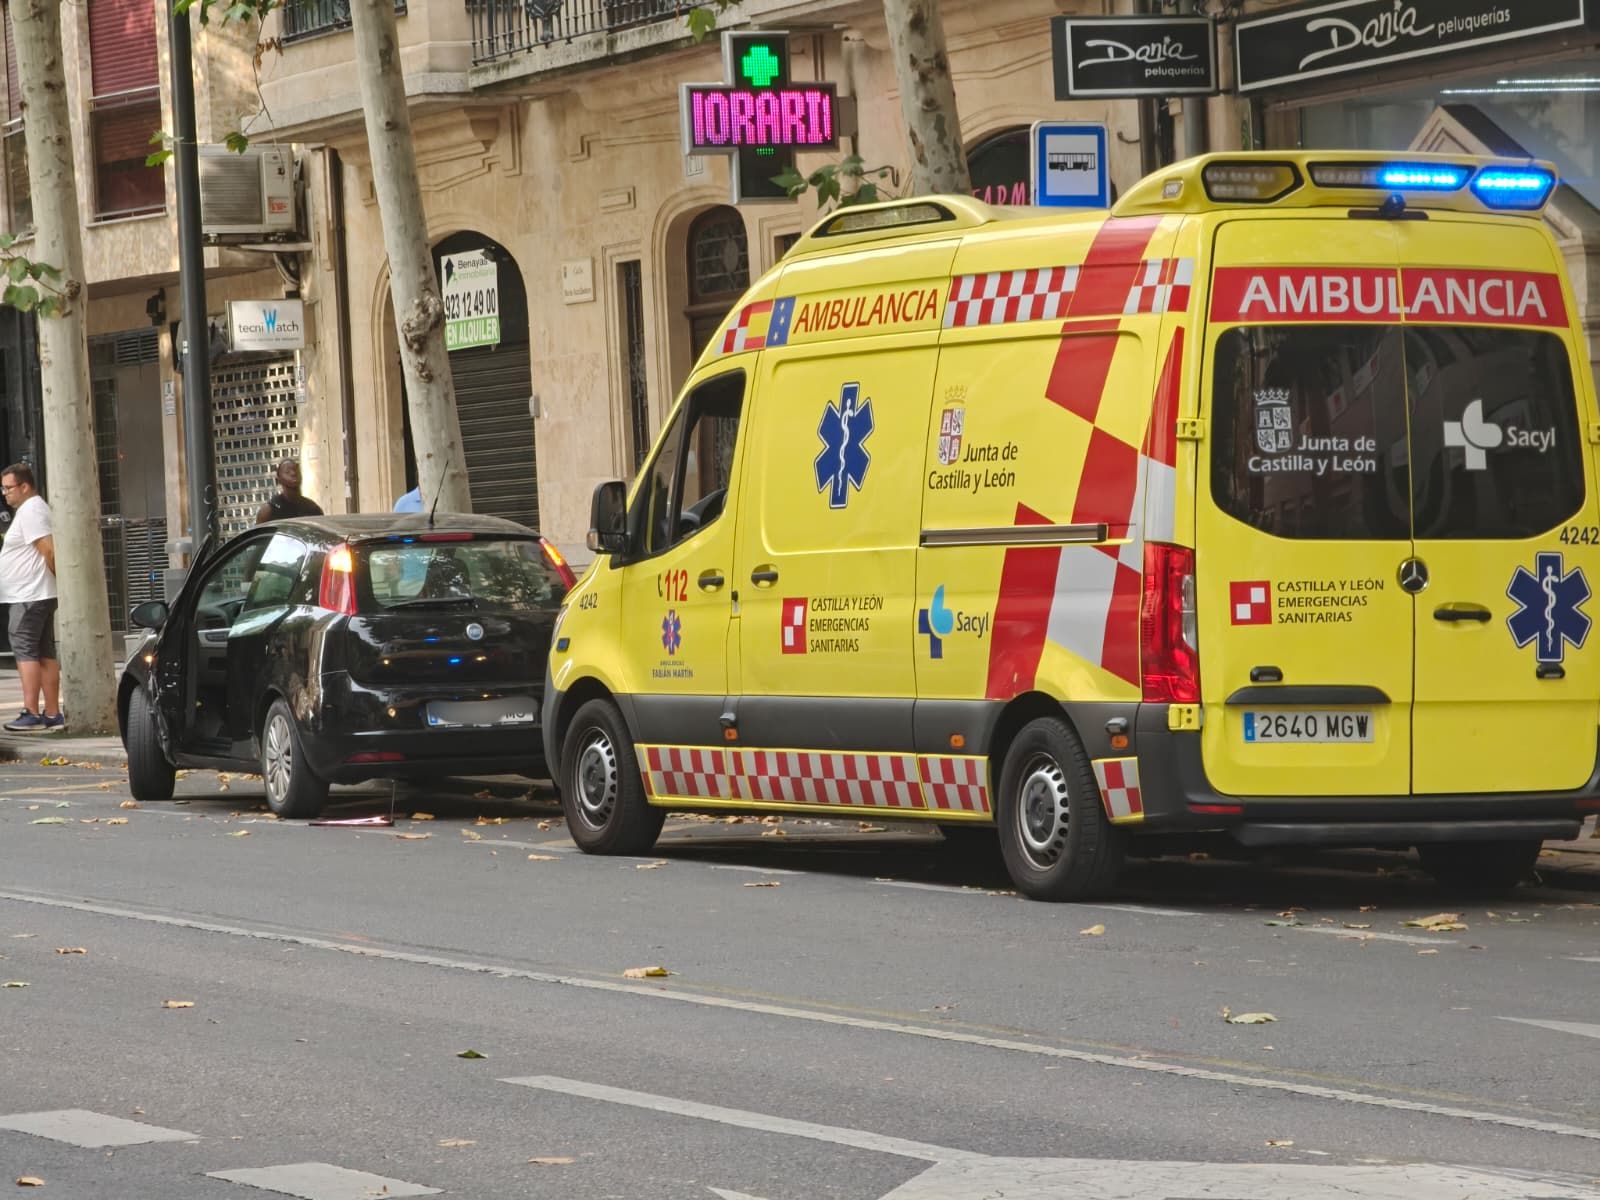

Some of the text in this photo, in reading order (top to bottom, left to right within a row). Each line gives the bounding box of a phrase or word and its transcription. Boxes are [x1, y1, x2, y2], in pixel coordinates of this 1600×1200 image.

[1299, 0, 1511, 70] Dania peluquerías
[1078, 35, 1199, 69] Dania
[445, 288, 496, 320] 923 12 49 00
[1238, 275, 1548, 318] AMBULANCIA
[793, 288, 938, 335] AMBULANCIA
[447, 317, 498, 345] EN ALQUILER
[1297, 434, 1377, 452] Junta de
[1507, 425, 1556, 452] Sacyl
[963, 441, 1018, 462] Junta de
[1248, 455, 1377, 476] Castilla y León
[928, 467, 1016, 495] Castilla y León
[1560, 526, 1600, 545] 4242
[665, 569, 688, 602] 112
[1277, 577, 1385, 592] CASTILLA Y LEÓN
[579, 592, 598, 610] 4242
[811, 593, 884, 612] CASTILLA Y LEÓN
[1278, 595, 1368, 608] EMERGENCIAS
[810, 617, 869, 632] EMERGENCIAS
[956, 611, 989, 639] Sacyl
[1278, 611, 1353, 624] SANITARIAS
[810, 638, 860, 653] SANITARIAS
[1260, 714, 1369, 738] 2640 MGW
